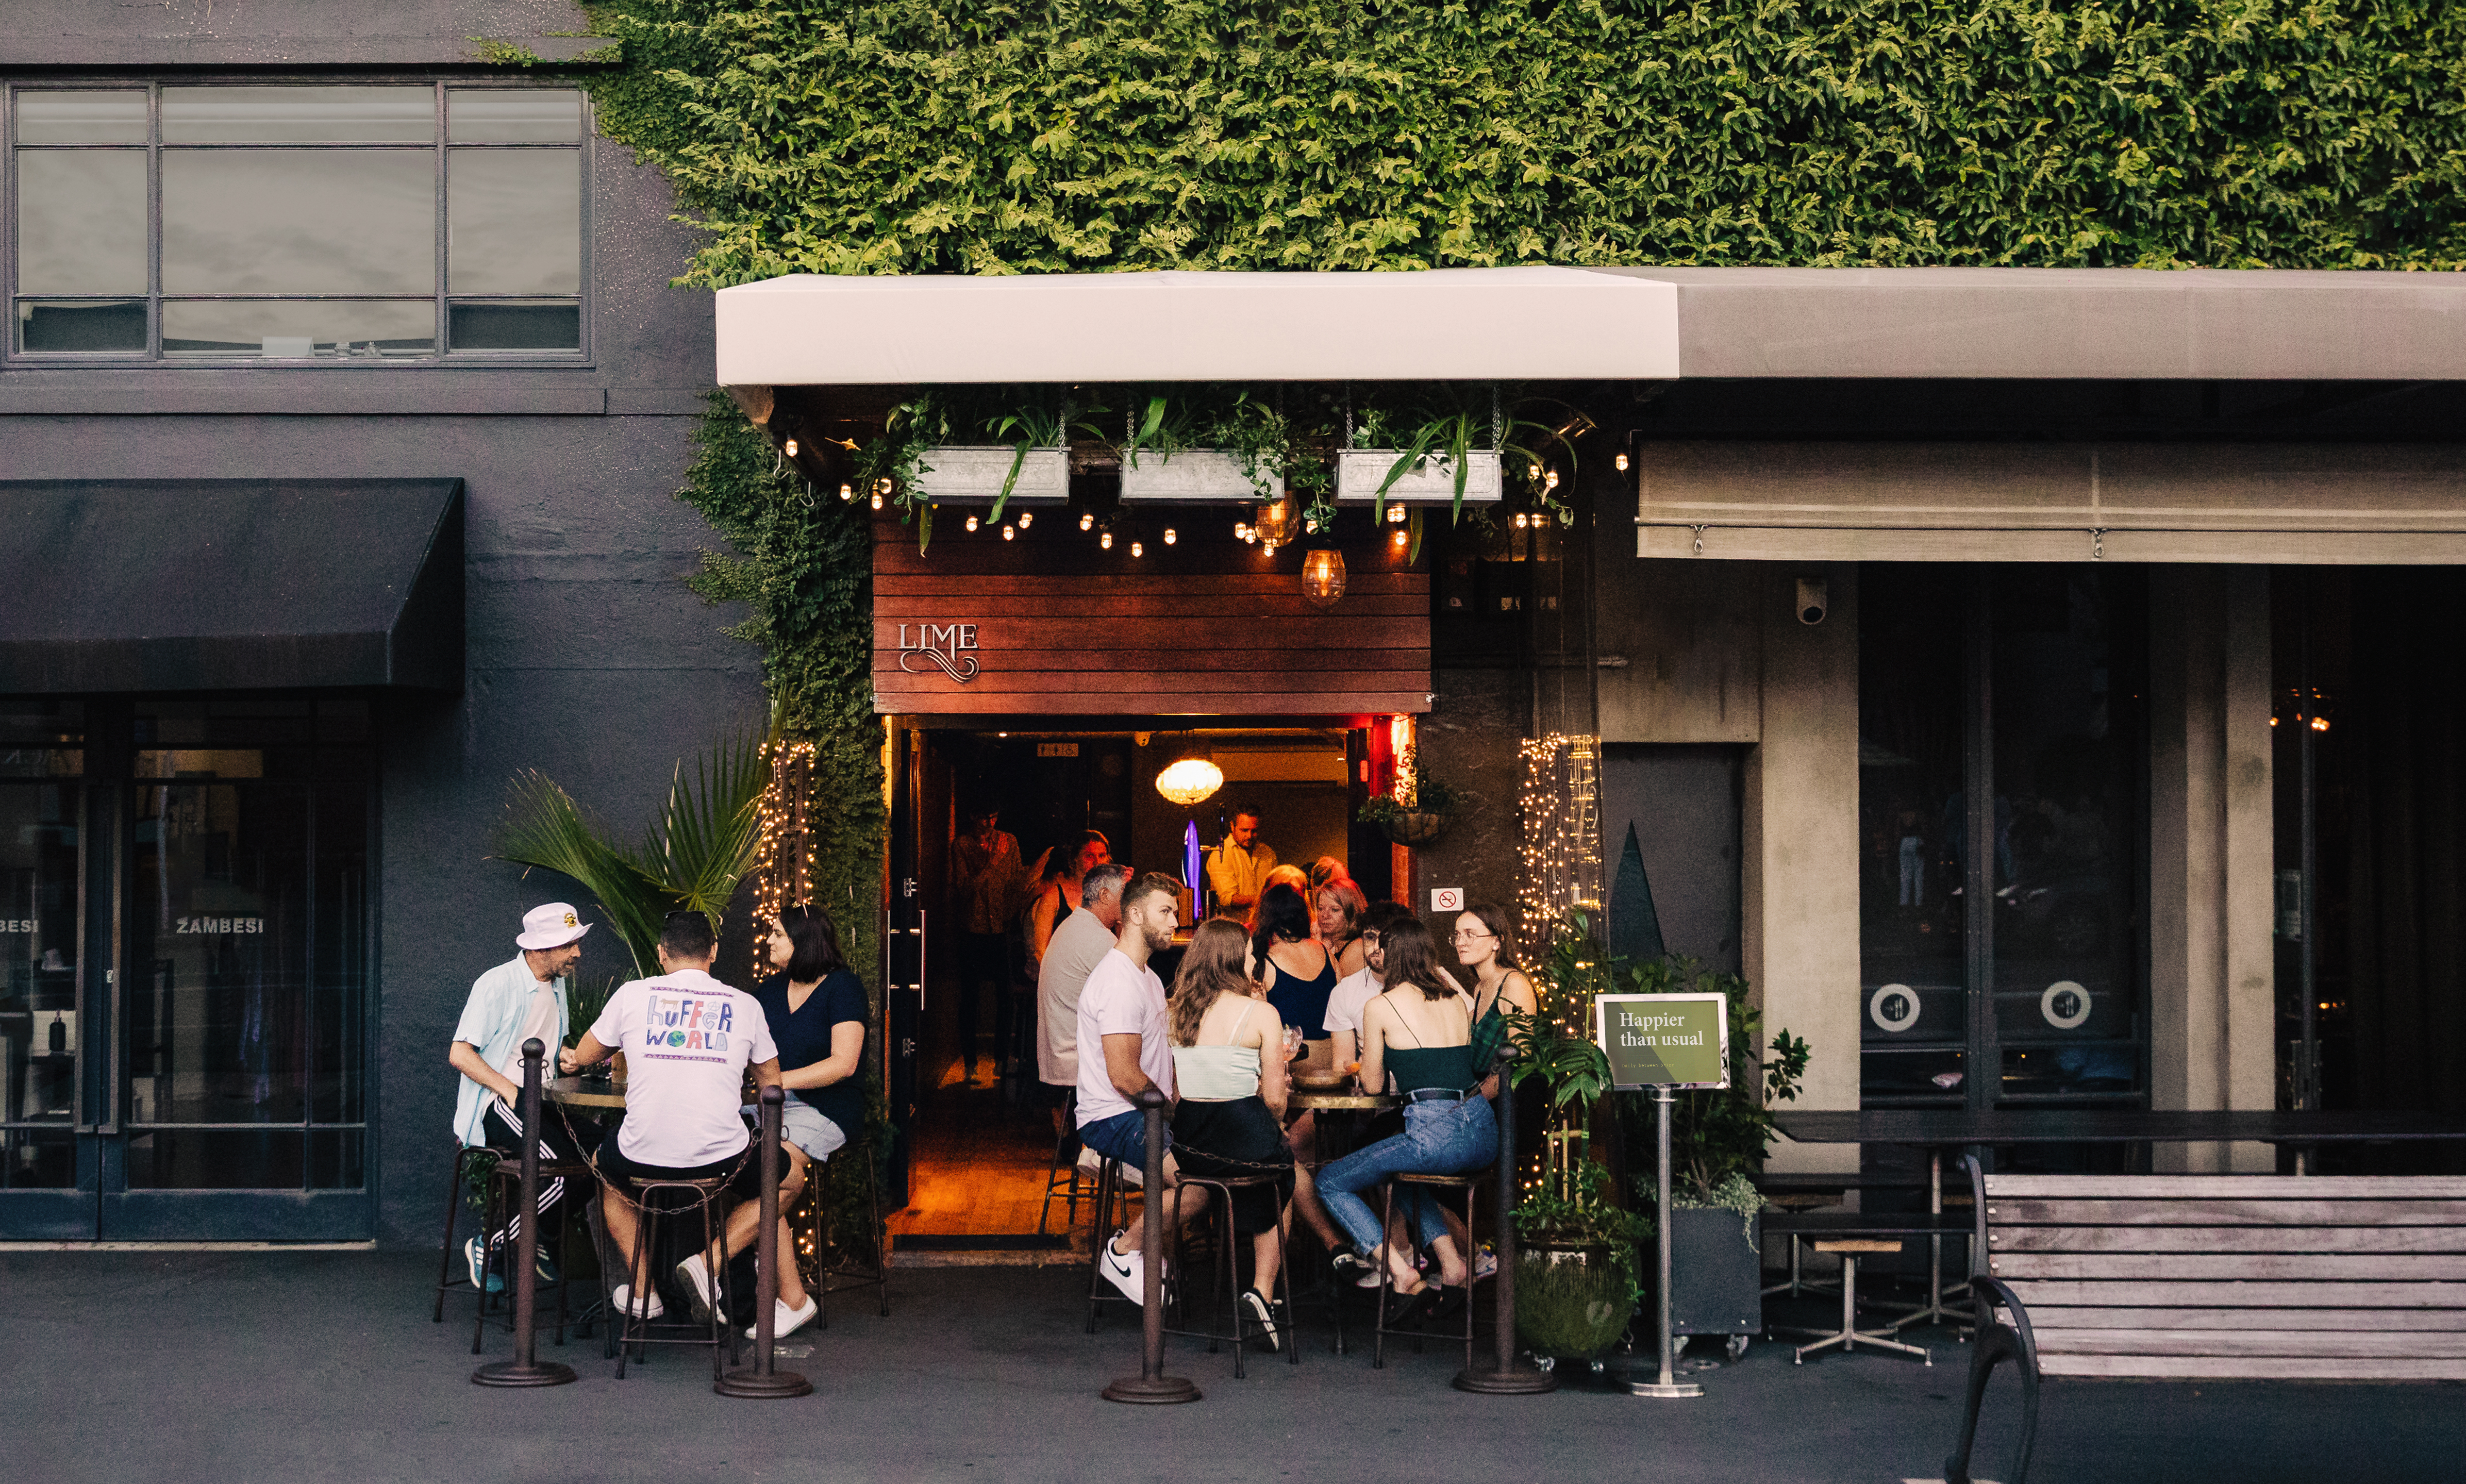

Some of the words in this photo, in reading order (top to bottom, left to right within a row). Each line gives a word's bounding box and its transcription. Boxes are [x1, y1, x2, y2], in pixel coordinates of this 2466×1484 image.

[898, 624, 978, 662] LIME
[176, 916, 264, 934] ZAMBESI
[1619, 1012, 1685, 1031] Happier
[1620, 1031, 1657, 1046] than
[1661, 1030, 1704, 1046] usual
